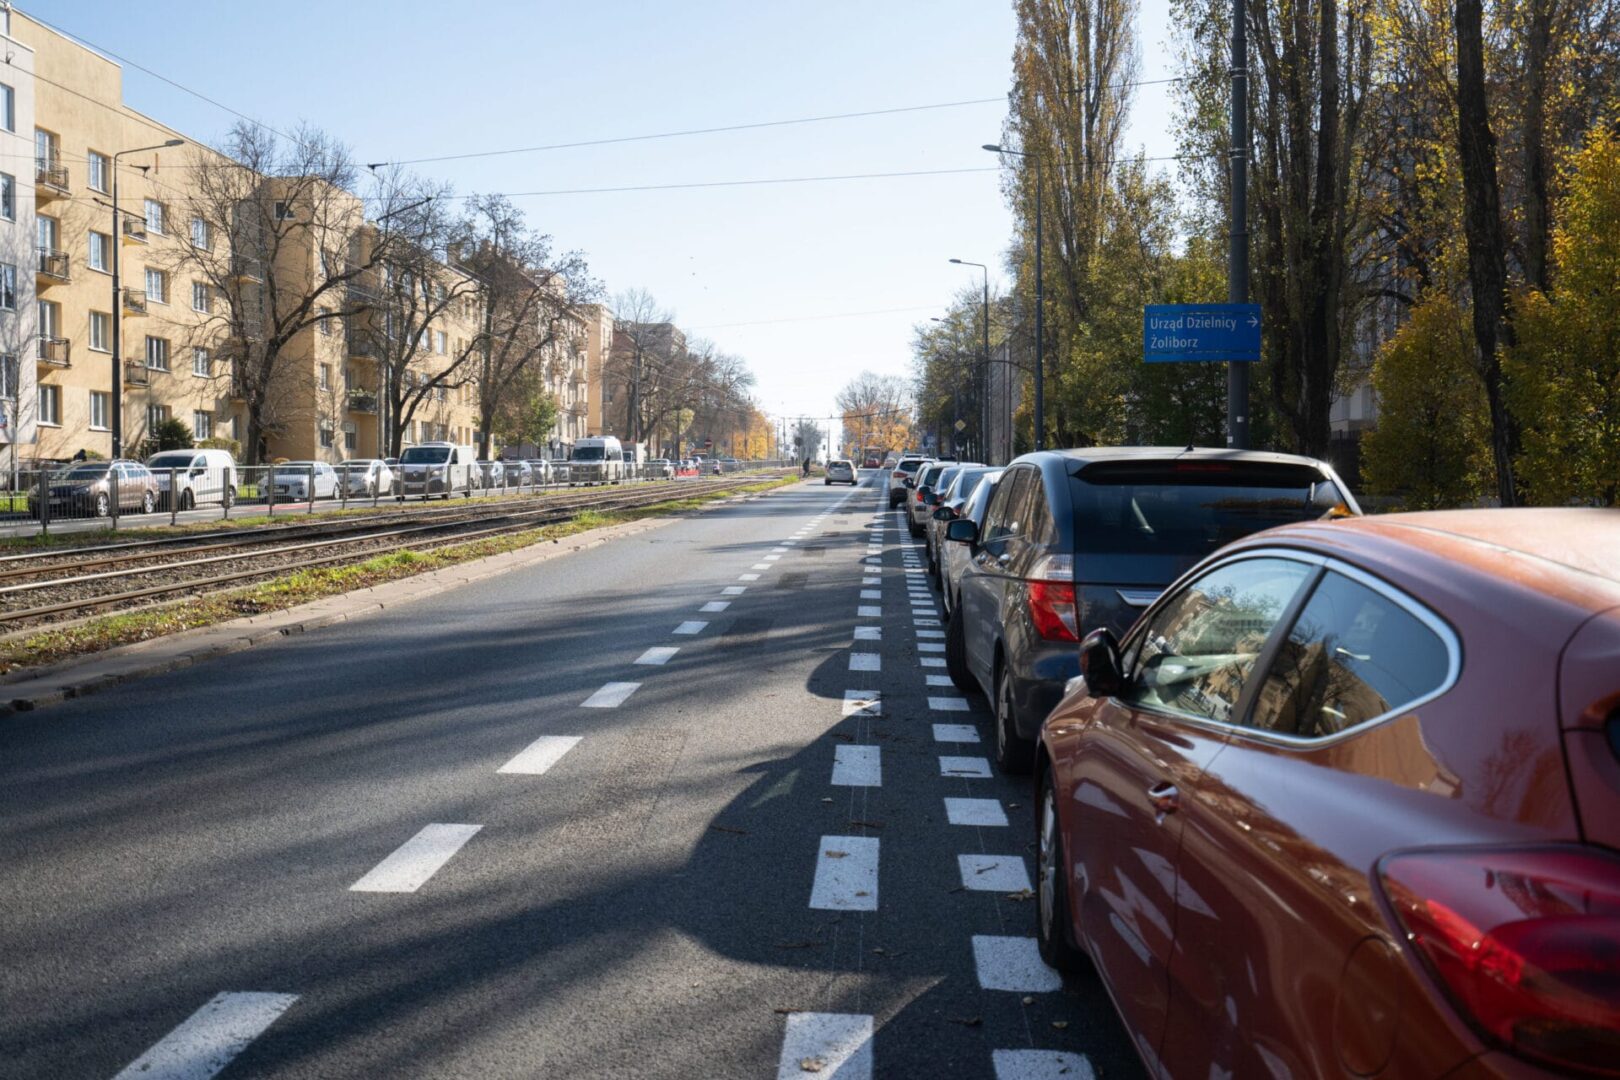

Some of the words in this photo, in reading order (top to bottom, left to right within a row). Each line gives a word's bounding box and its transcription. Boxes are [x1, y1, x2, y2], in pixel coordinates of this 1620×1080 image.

[1150, 317, 1183, 331] Urząd
[1186, 316, 1237, 331] Dzielnicy
[1150, 334, 1199, 349] Żoliborz
